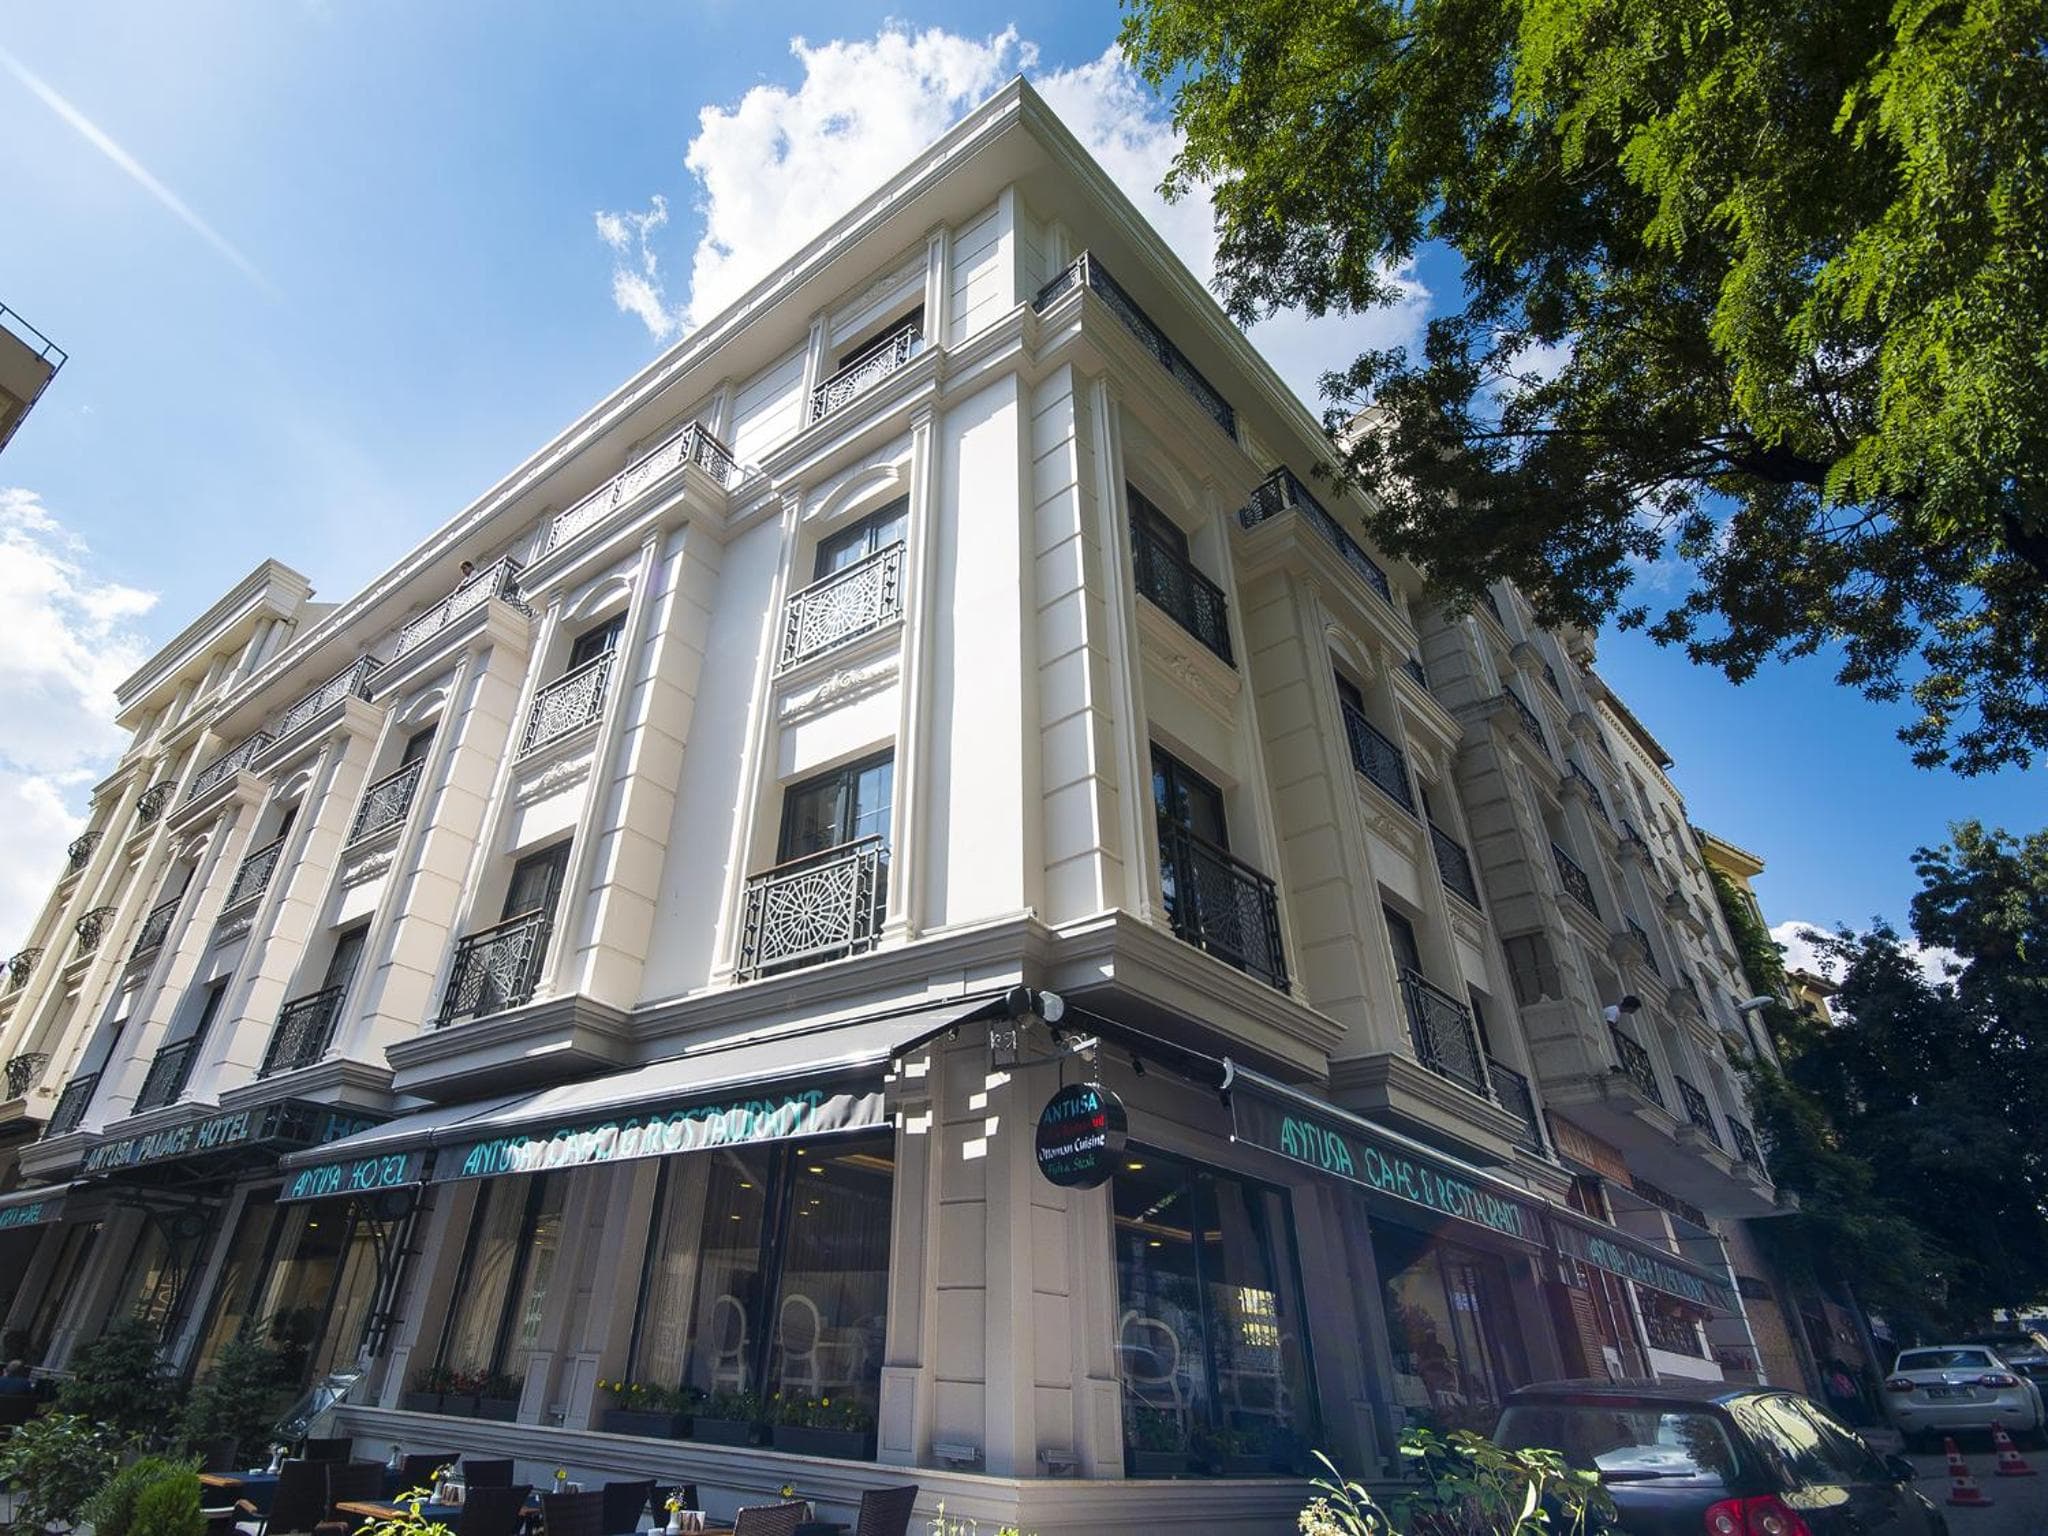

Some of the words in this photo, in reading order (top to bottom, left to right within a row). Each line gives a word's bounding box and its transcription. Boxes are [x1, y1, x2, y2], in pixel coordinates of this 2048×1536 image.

[137, 1125, 194, 1160] PALACE
[195, 1111, 250, 1149] HOTEL
[1074, 1133, 1105, 1152] Cuisine
[347, 1154, 407, 1190] HOTEL
[1280, 1116, 1354, 1177] ANTUSA
[1364, 1147, 1419, 1200] CAFE
